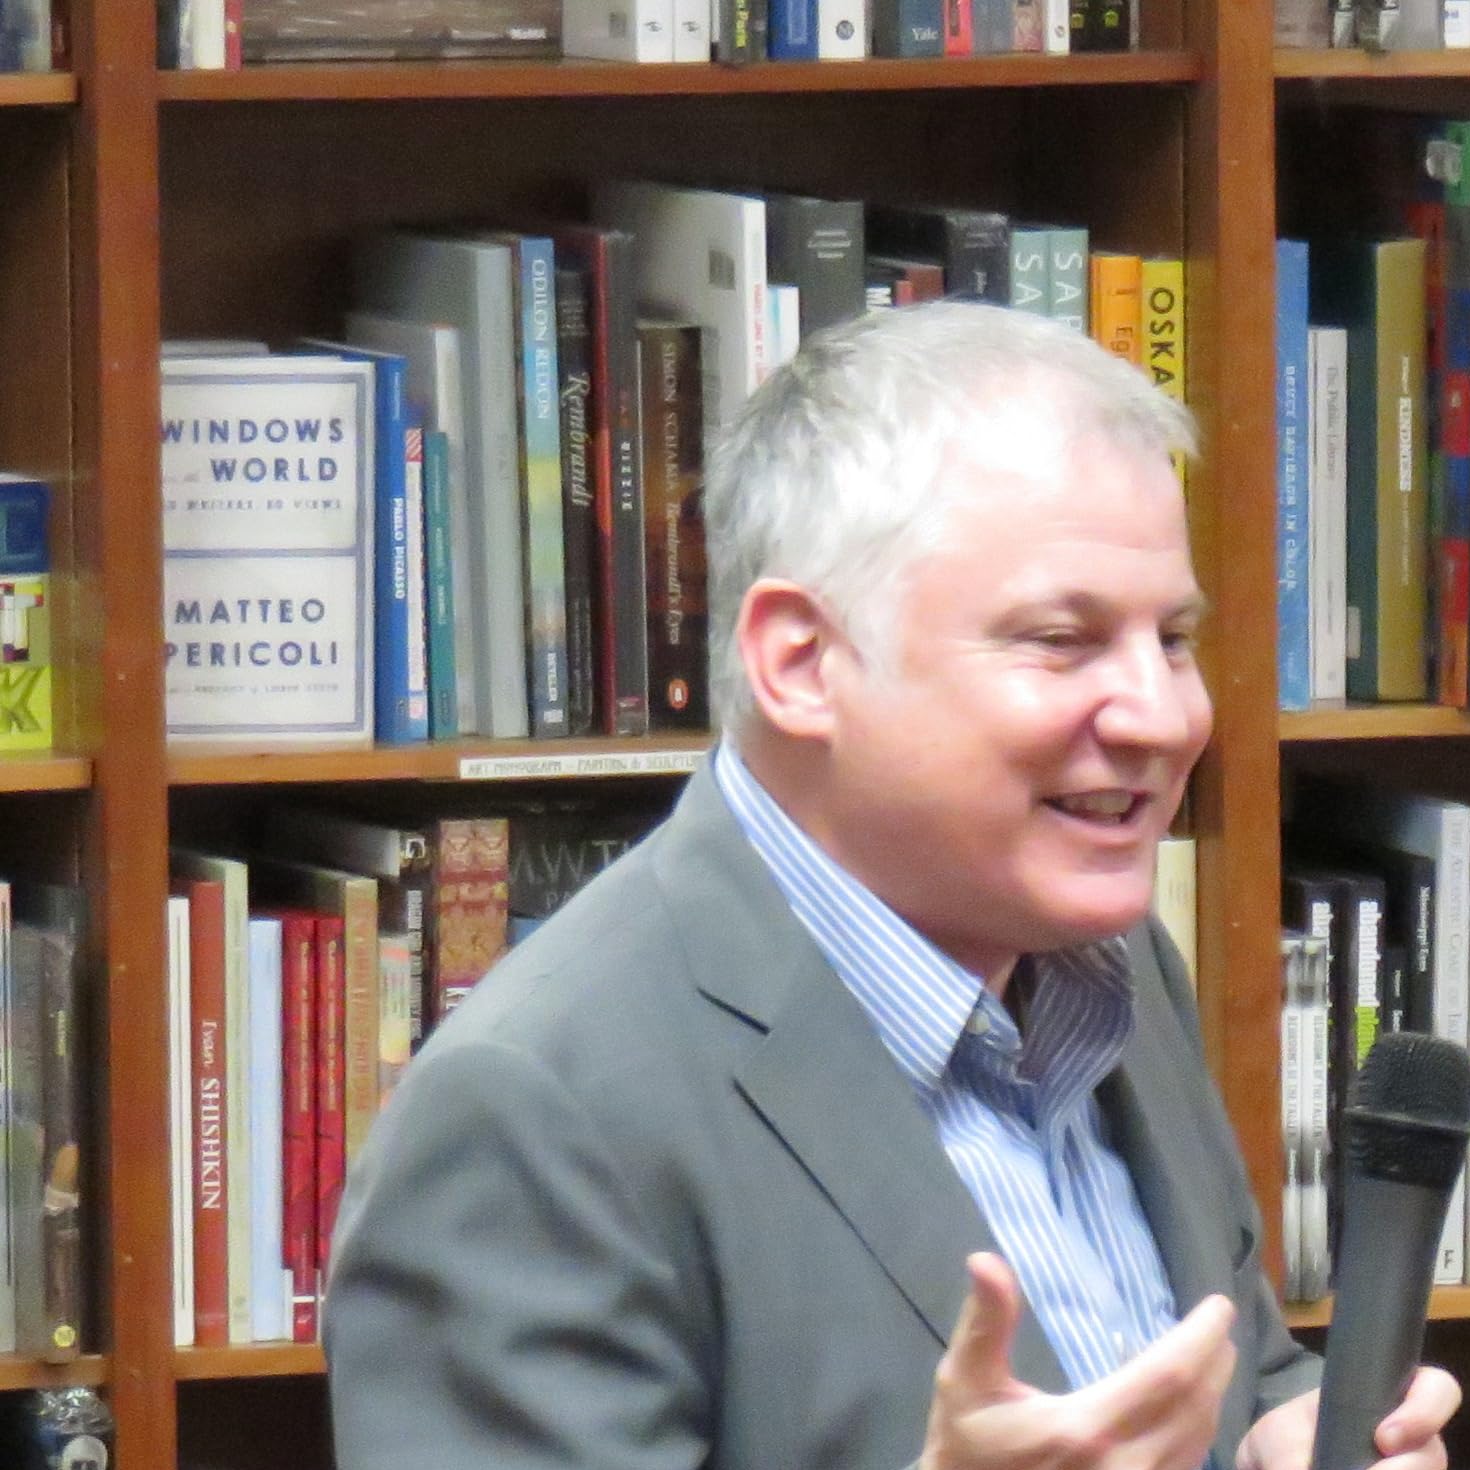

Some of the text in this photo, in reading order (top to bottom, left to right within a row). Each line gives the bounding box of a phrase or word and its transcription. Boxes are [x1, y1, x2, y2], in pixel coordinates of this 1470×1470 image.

[911, 27, 939, 43] Yale
[532, 259, 551, 420] ODILON REDON
[662, 342, 678, 403] SIMON
[1150, 287, 1175, 390] OSKA
[161, 418, 345, 444] WINDOWS
[562, 370, 593, 507] Rembrandt
[663, 412, 681, 493] SCHAMA
[209, 457, 339, 483] WORLD
[393, 497, 406, 600] PABLO PICASSO
[174, 598, 326, 625] MATTEO
[666, 608, 683, 645] Eyes
[164, 640, 339, 668] PERICOLI
[1359, 901, 1381, 1007] abandoned
[200, 1018, 221, 1209] Ivan SHISHKIN
